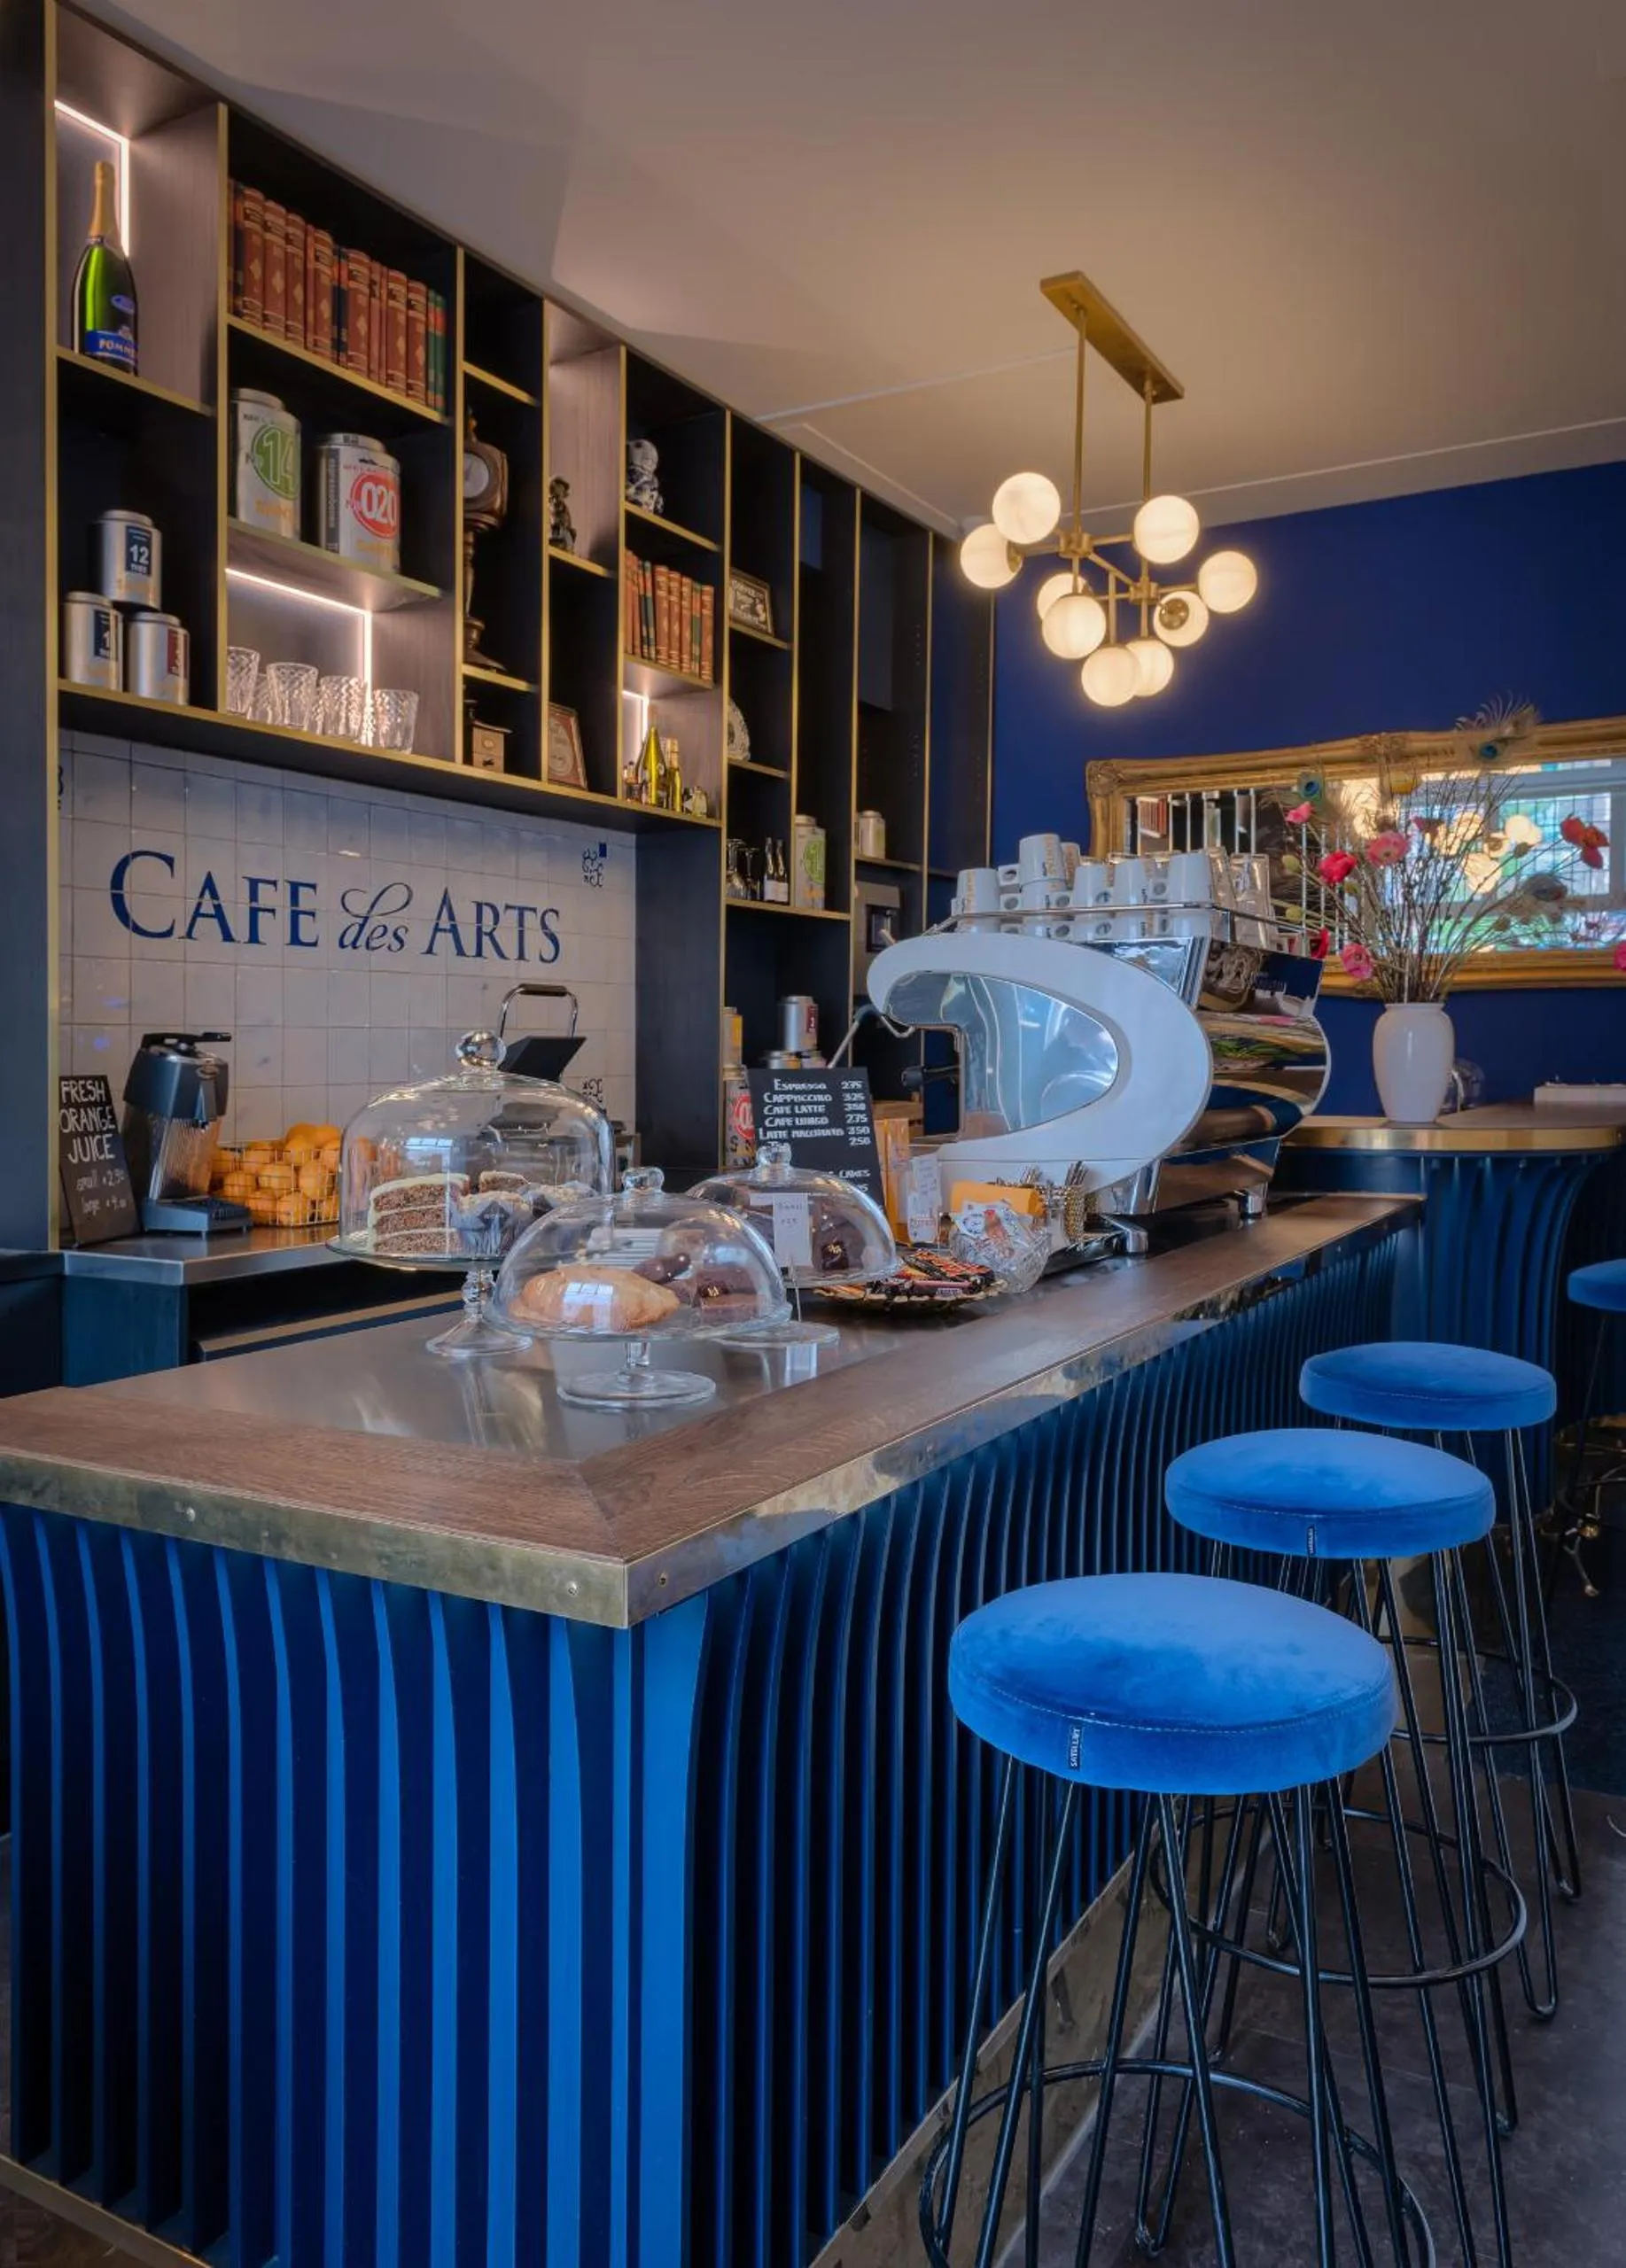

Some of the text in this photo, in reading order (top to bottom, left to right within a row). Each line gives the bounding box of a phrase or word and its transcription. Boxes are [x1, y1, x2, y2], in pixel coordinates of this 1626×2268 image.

[264, 428, 295, 495] 14
[361, 482, 398, 527] 020
[129, 544, 150, 564] 12
[111, 850, 561, 964] CAFE des ARTS
[61, 1079, 105, 1103] FRESH
[59, 1107, 116, 1133] ORANGE
[794, 1105, 826, 1114] LATTE
[67, 1134, 115, 1164] JUICE
